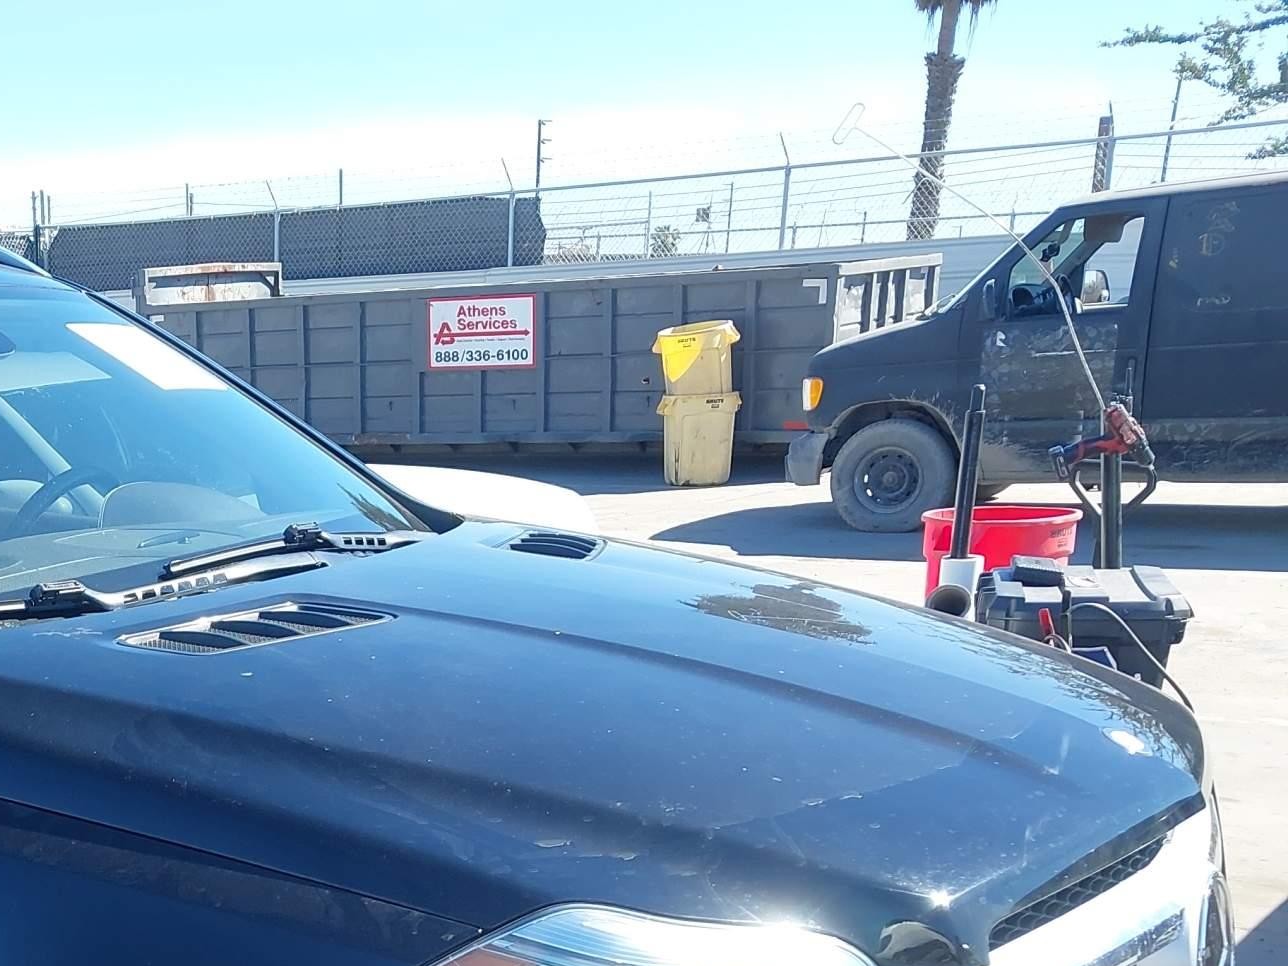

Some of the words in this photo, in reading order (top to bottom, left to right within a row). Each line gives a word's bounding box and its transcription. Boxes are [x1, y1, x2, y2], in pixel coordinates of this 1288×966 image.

[456, 305, 507, 318] Athens
[457, 317, 518, 331] Services
[434, 348, 529, 363] 888/336-6100
